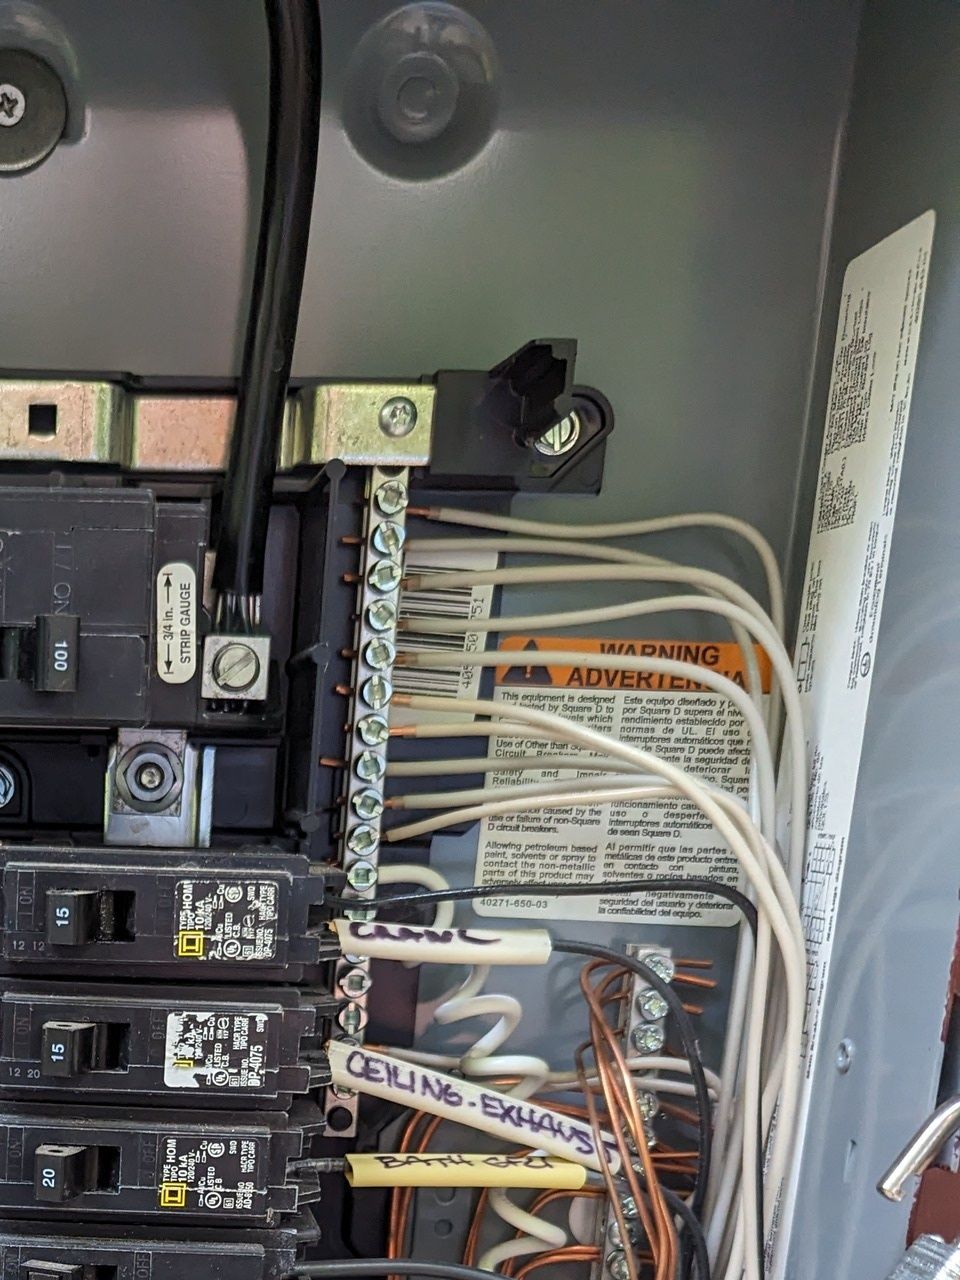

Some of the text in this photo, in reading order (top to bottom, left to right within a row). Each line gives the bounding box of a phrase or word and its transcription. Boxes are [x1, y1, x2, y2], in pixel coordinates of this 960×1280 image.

[180, 582, 191, 664] STRIP GAUGE
[54, 641, 68, 671] 100
[600, 643, 720, 666] WARNING
[501, 692, 616, 706] This equipment designed
[624, 696, 716, 707] Este equipo diseñado
[548, 704, 559, 714] by
[562, 704, 592, 715] Square
[605, 705, 614, 713] to
[622, 706, 713, 717] por Square supera
[587, 714, 613, 723] which
[621, 716, 744, 728] rendimiento establecido por
[662, 726, 674, 734] de
[496, 740, 568, 750] Use Other than
[727, 738, 741, 746] que
[495, 749, 526, 758] Circuit
[655, 745, 724, 755] Square puede
[695, 756, 739, 765] seguridad
[541, 770, 559, 778] and
[684, 765, 731, 774] deteriorar
[543, 808, 602, 817] caused by the
[610, 810, 627, 818] uso
[554, 816, 601, 827] non-Square
[496, 824, 520, 832] circuit
[607, 828, 618, 836] de
[642, 829, 671, 839] Square
[485, 842, 597, 853] Allowing petroleum based
[658, 846, 676, 854] que
[680, 845, 693, 853] las
[697, 847, 726, 855] partes
[512, 852, 546, 860] solvents
[561, 854, 585, 863] spray
[645, 853, 655, 861] de
[677, 855, 712, 864] producto
[483, 860, 517, 868] contact
[539, 862, 595, 871] non-metallic
[483, 870, 505, 878] parts
[539, 871, 572, 880] product
[576, 872, 594, 881] may
[603, 871, 644, 879] solventes
[645, 892, 714, 900] negativamente
[480, 899, 548, 908] 40271-650-03
[600, 898, 735, 910] seguridad del usuario deteriorar
[56, 907, 70, 926] 15
[225, 912, 233, 938] LISTED
[52, 1043, 64, 1062] 15
[214, 1043, 222, 1067] LISTED
[248, 1045, 263, 1086] DP-4075
[166, 1139, 176, 1163] HOM
[42, 1168, 55, 1187] 20
